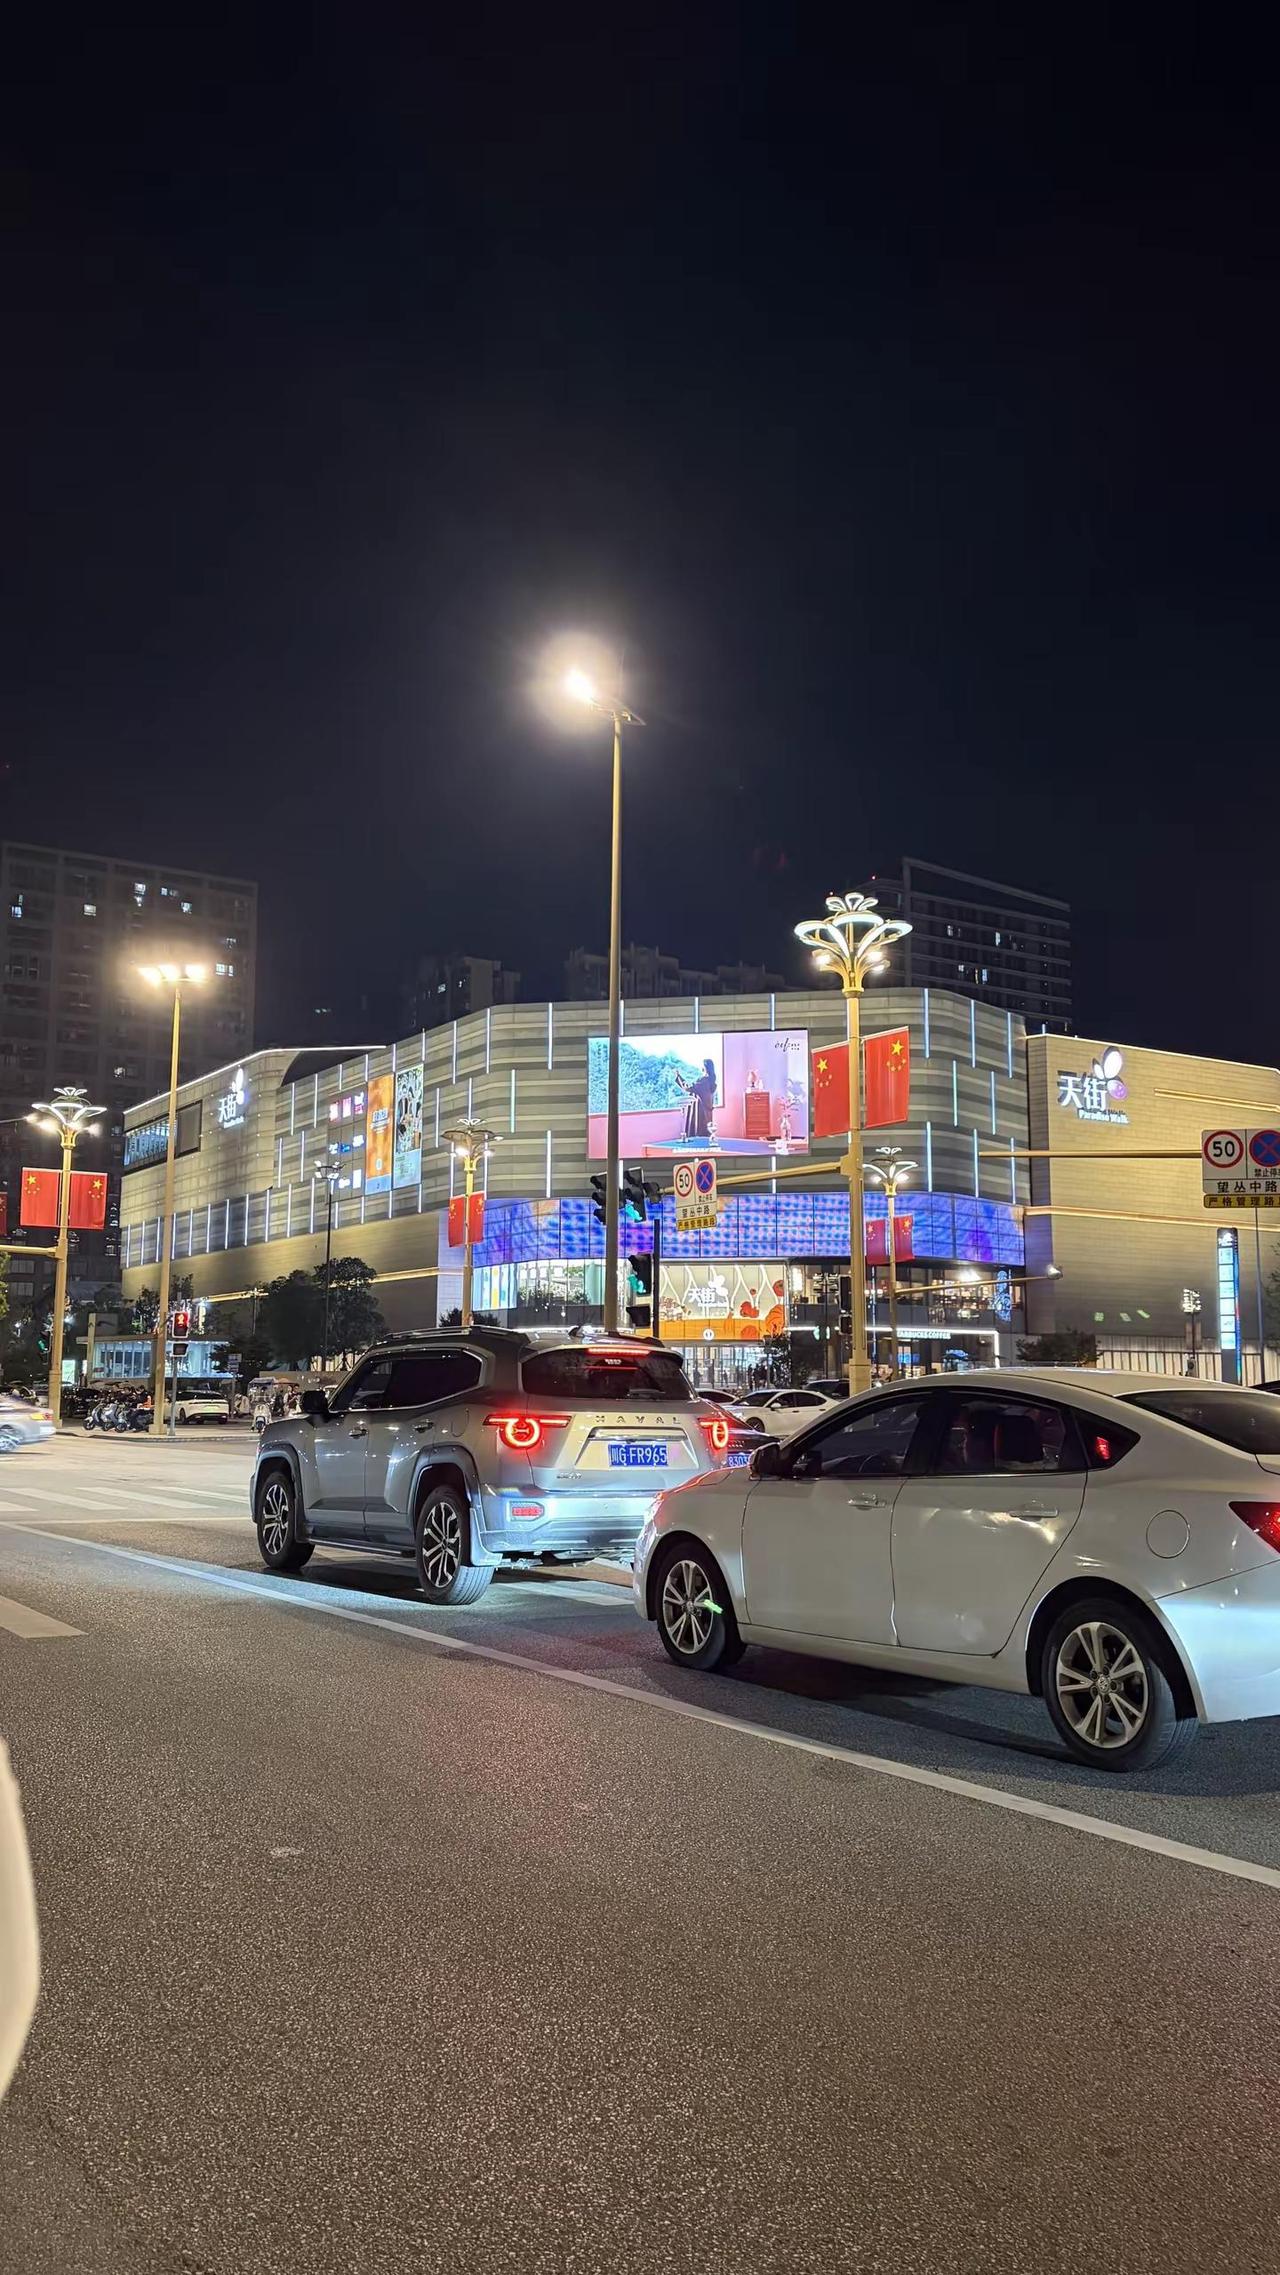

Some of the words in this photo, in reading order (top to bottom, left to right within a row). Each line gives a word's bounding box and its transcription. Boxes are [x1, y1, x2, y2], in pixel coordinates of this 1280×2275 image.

[1059, 1075, 1107, 1111] 天街
[1212, 1141, 1235, 1158] 50
[1254, 1168, 1280, 1178] 禁止停
[679, 1173, 690, 1189] 50
[1217, 1181, 1277, 1193] 望丛中路
[1208, 1196, 1280, 1207] 严格管理路
[688, 1287, 716, 1303] 天街
[595, 1415, 681, 1424] HAVAL
